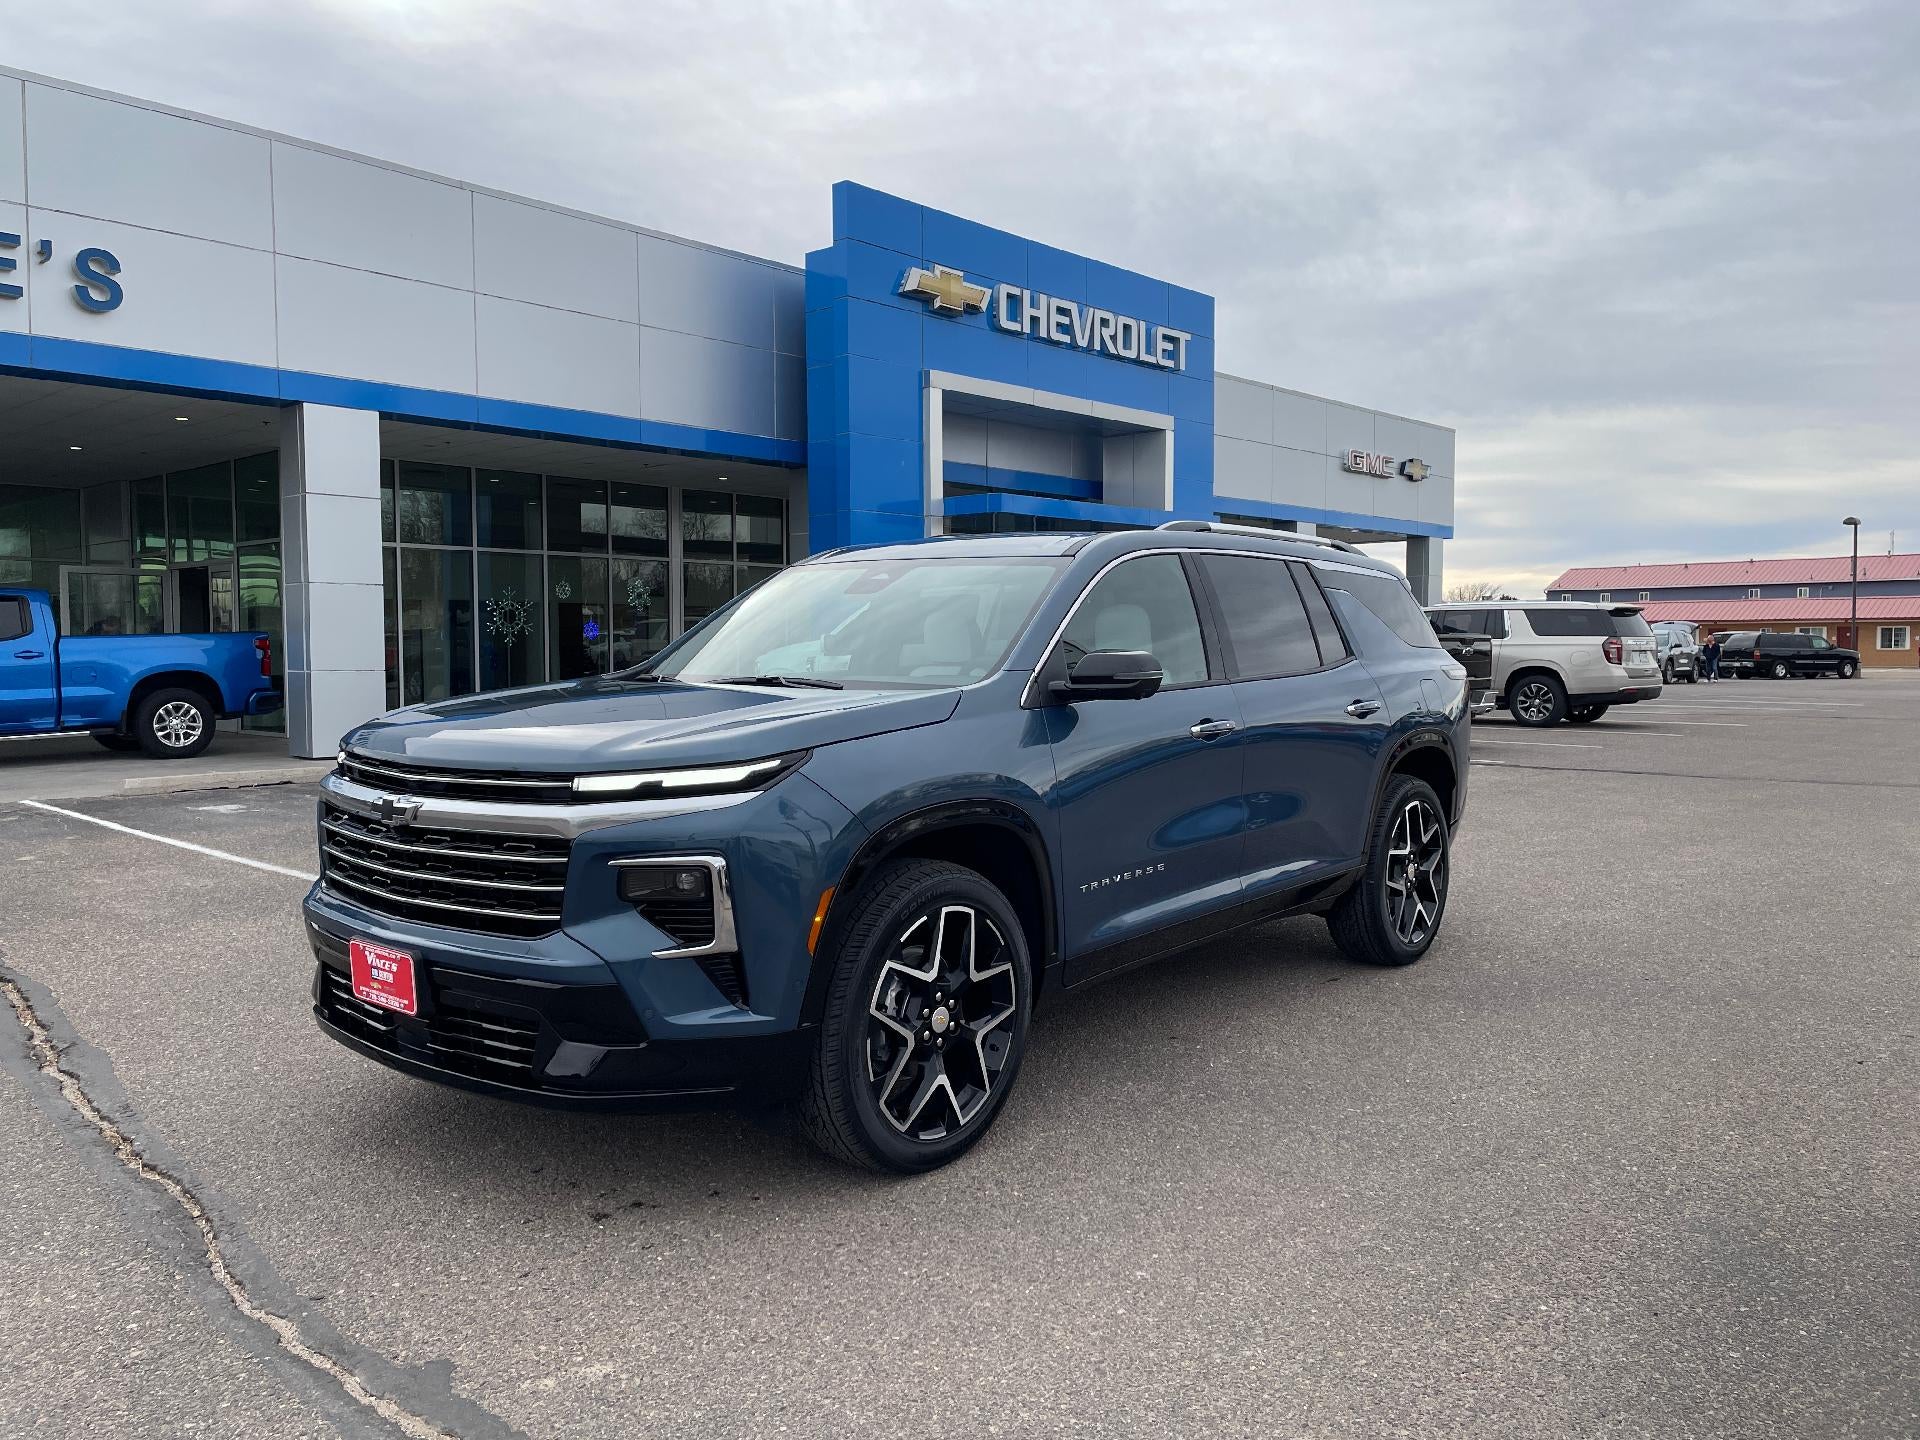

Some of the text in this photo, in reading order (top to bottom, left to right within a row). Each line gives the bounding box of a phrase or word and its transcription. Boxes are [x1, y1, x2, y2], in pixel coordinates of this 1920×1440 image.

[993, 283, 1192, 371] CHEVROLET
[1344, 448, 1395, 479] GMC
[1079, 863, 1165, 893] TRAVERSE
